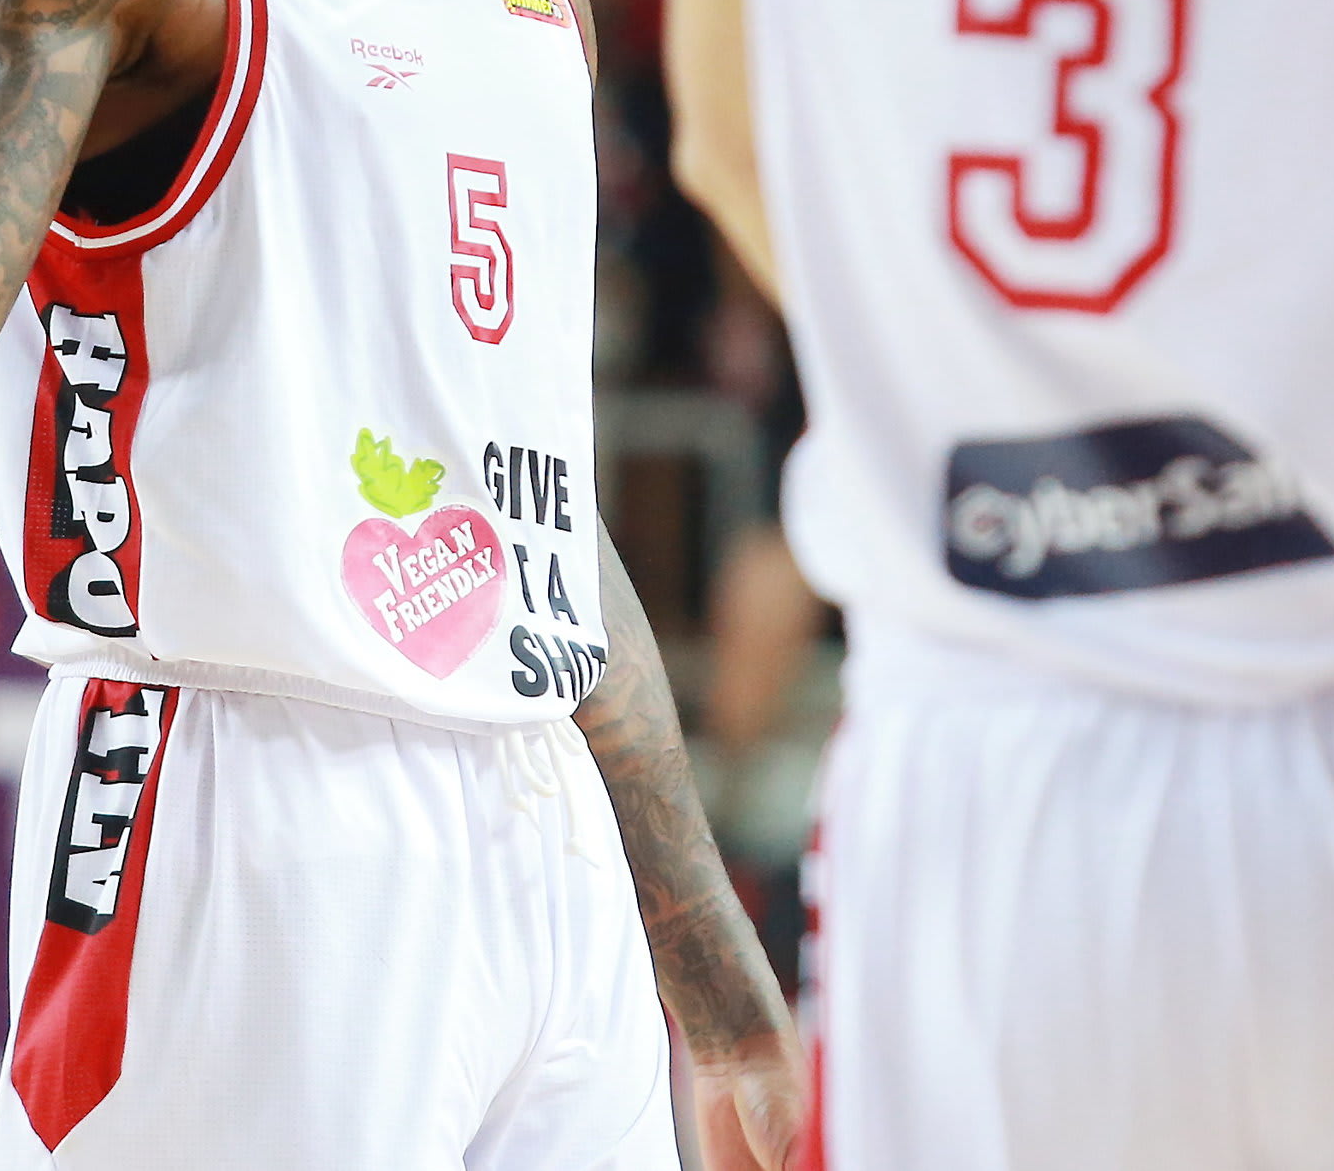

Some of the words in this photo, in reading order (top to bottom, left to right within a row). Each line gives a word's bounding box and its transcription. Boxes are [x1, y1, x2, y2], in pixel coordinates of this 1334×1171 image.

[350, 37, 425, 67] Reebok
[446, 151, 515, 345] 5
[483, 440, 572, 533] GIVE
[371, 520, 477, 596] VEGAN
[372, 545, 499, 644] FRIENDLY
[547, 552, 580, 626] A
[63, 687, 165, 917] TLV
